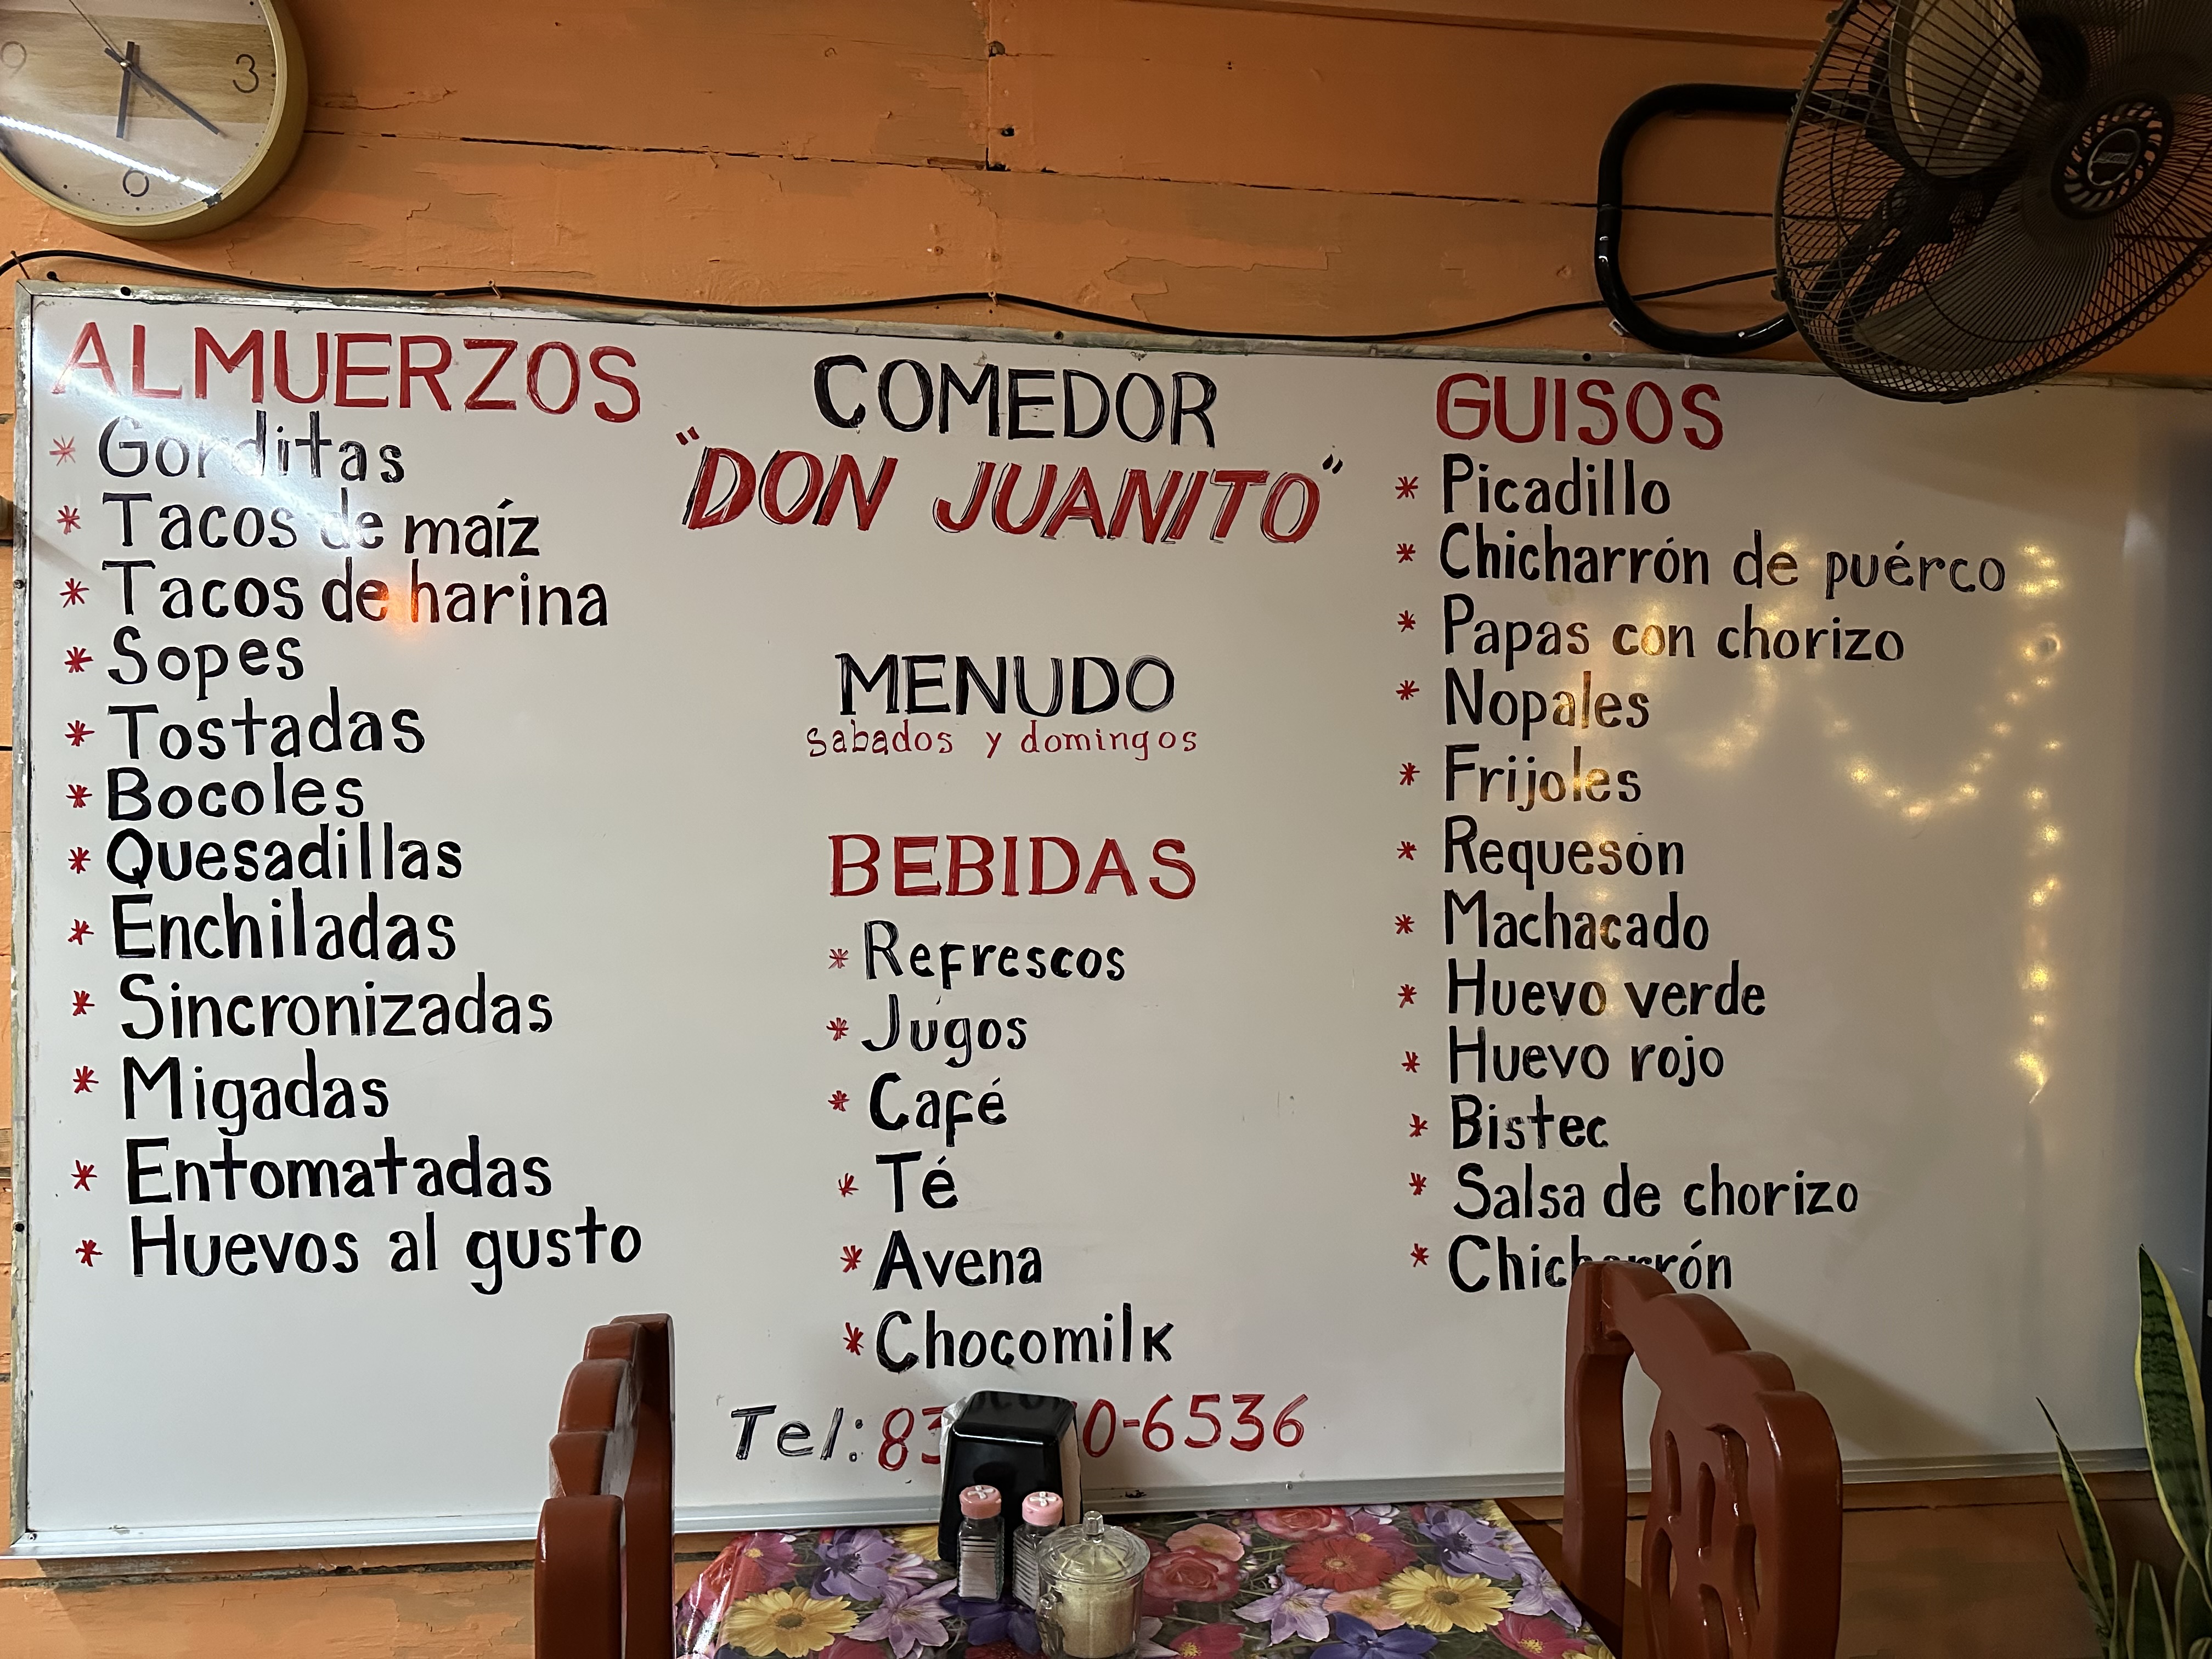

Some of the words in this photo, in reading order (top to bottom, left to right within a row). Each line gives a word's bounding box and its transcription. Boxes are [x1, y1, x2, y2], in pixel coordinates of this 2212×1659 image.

[232, 54, 259, 93] 3
[51, 321, 641, 423] ALMUERZOS
[813, 353, 1217, 448] COMEDOR
[98, 410, 405, 483] Gorditas
[1436, 373, 1724, 451] GUISOS
[1442, 453, 1671, 517] Picadillo
[102, 491, 297, 550] Tacos
[320, 487, 385, 550] de
[404, 497, 540, 558] maíz
[101, 559, 304, 620] Tacos
[321, 556, 390, 623] de
[410, 558, 609, 627] harina
[1440, 522, 1710, 586] Chicharrón
[1733, 529, 1798, 589] de
[1826, 540, 2006, 600] puérco
[107, 625, 304, 701] Sopes
[1442, 593, 1589, 672] Papas
[1612, 622, 1695, 659] con
[1717, 603, 1905, 662] chorizo
[834, 653, 1176, 717] MENUDO
[1444, 668, 1650, 741] Nopales
[108, 686, 426, 761] Tostadas
[806, 719, 953, 757] sabados
[986, 732, 1001, 759] y
[1020, 719, 1198, 761] domingos
[107, 763, 364, 821] Bocoles
[1444, 743, 1641, 812] Frijoles
[107, 822, 462, 889] Quesadillas
[827, 833, 1198, 900] BEBIDAS
[1443, 814, 1684, 890] Requesón
[111, 887, 456, 961] Enchiladas
[864, 919, 1126, 991] Refrescos
[1443, 889, 1709, 951] Machacado
[119, 972, 552, 1039] Sincronizadas
[1447, 958, 1607, 1017] Huevo
[1624, 960, 1767, 1019] verde
[861, 994, 1028, 1068] Jugos
[1449, 1025, 1609, 1085] Huevo
[1630, 1035, 1724, 1087] rojo
[123, 1048, 390, 1137] Migadas
[869, 1072, 1008, 1148] Café
[1450, 1093, 1609, 1150] Bistec
[126, 1135, 551, 1205] Entomatadas
[876, 1151, 960, 1213] Té
[1453, 1162, 1585, 1220] Salsa
[1602, 1162, 1661, 1218] de
[1683, 1163, 1858, 1216] chorizo
[131, 1214, 359, 1277] Huevos
[389, 1212, 438, 1272] al
[466, 1206, 642, 1295] gusto
[872, 1229, 1043, 1291] Avena
[1448, 1234, 1732, 1293] Chichrón
[876, 1303, 1175, 1374] Chocomilk
[731, 1404, 864, 1462] Tel:
